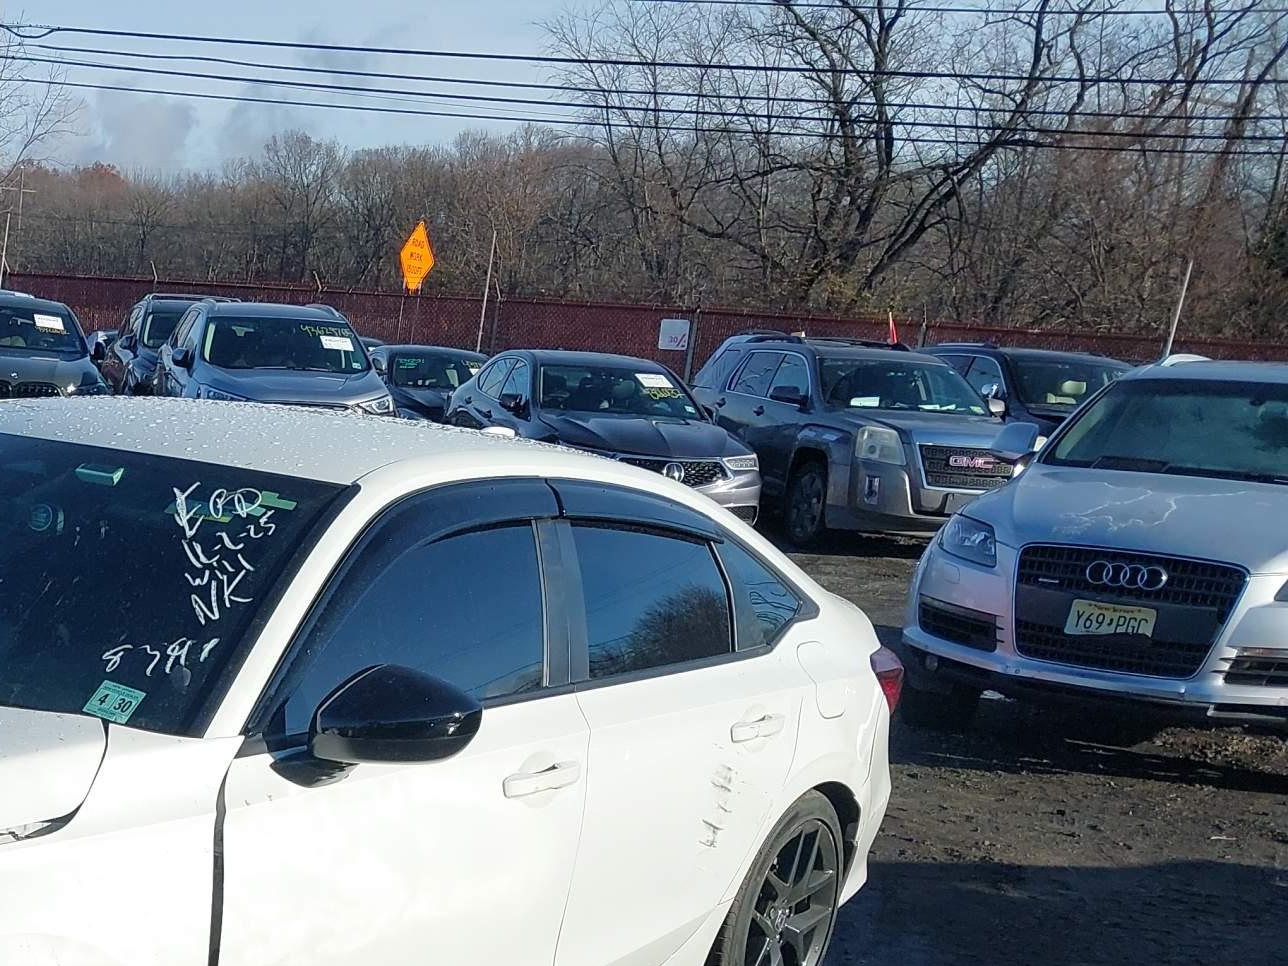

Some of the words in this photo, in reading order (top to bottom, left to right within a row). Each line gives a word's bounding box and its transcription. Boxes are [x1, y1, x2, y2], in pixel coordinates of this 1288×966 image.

[949, 455, 994, 469] GMC
[98, 693, 110, 706] 4
[113, 698, 133, 713] 30
